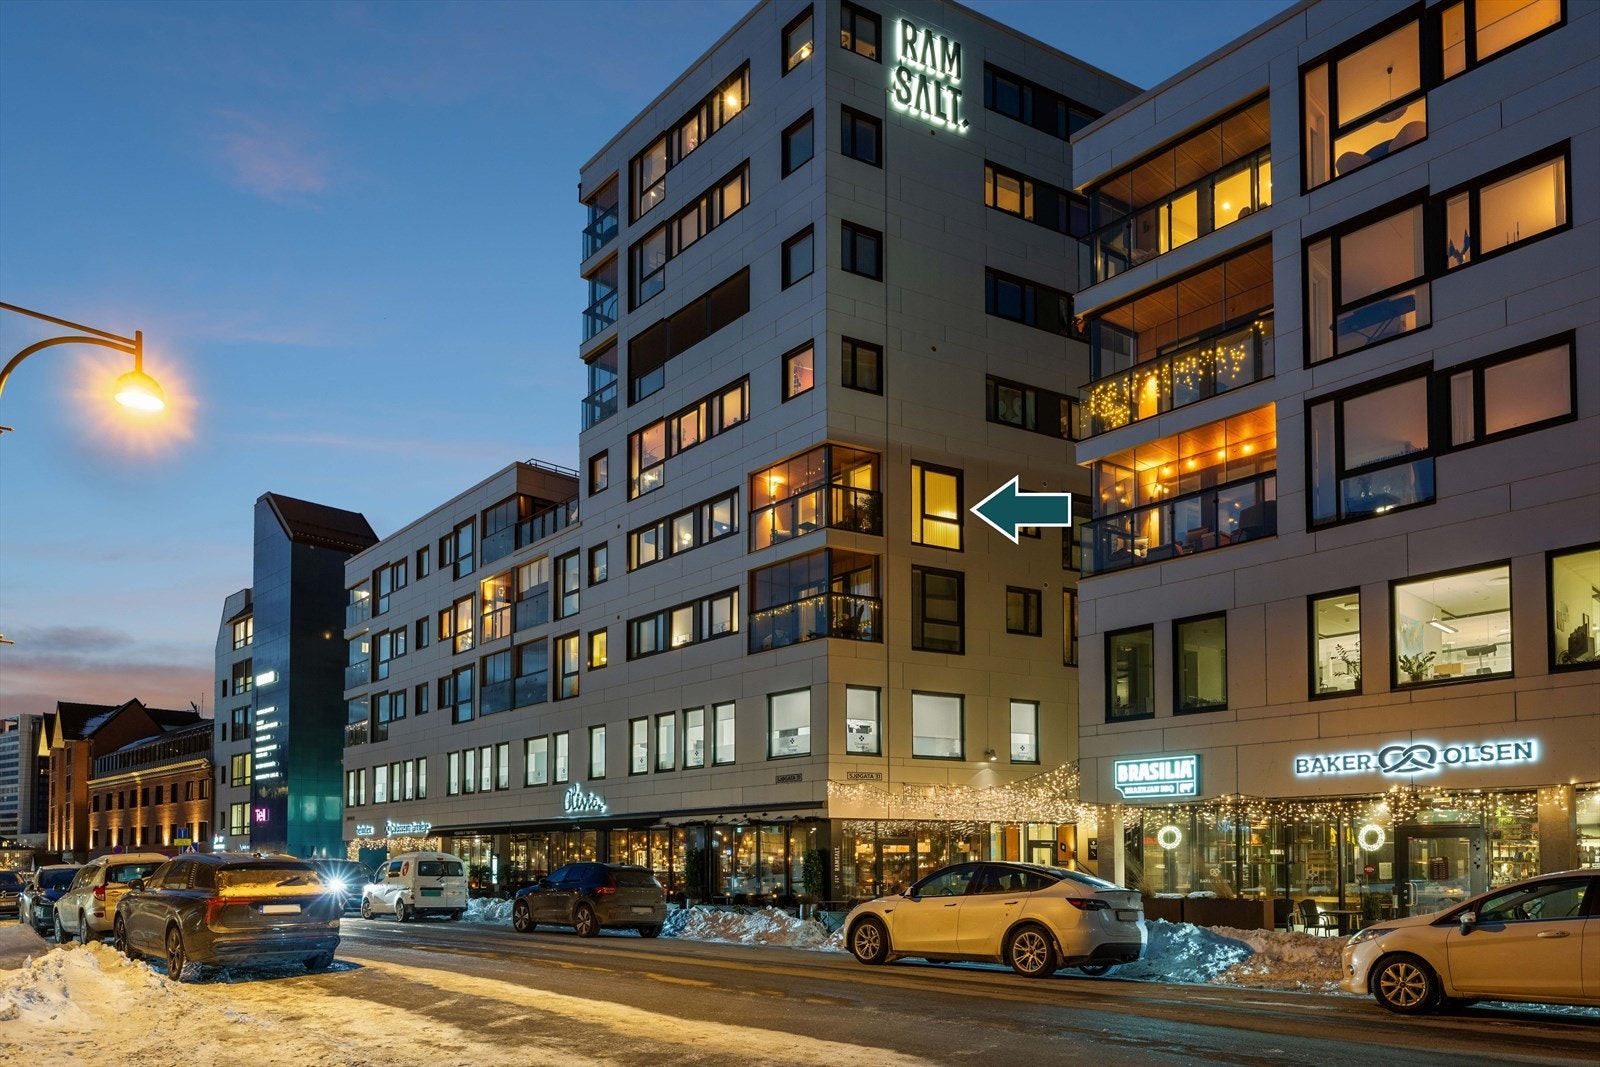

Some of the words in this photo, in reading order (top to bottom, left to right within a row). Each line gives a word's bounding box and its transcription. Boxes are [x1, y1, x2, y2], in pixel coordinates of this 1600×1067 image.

[899, 18, 962, 81] RAM
[1117, 760, 1193, 782] BRASILIA
[1296, 754, 1372, 774] BAKER
[1443, 742, 1533, 763] OLSEN
